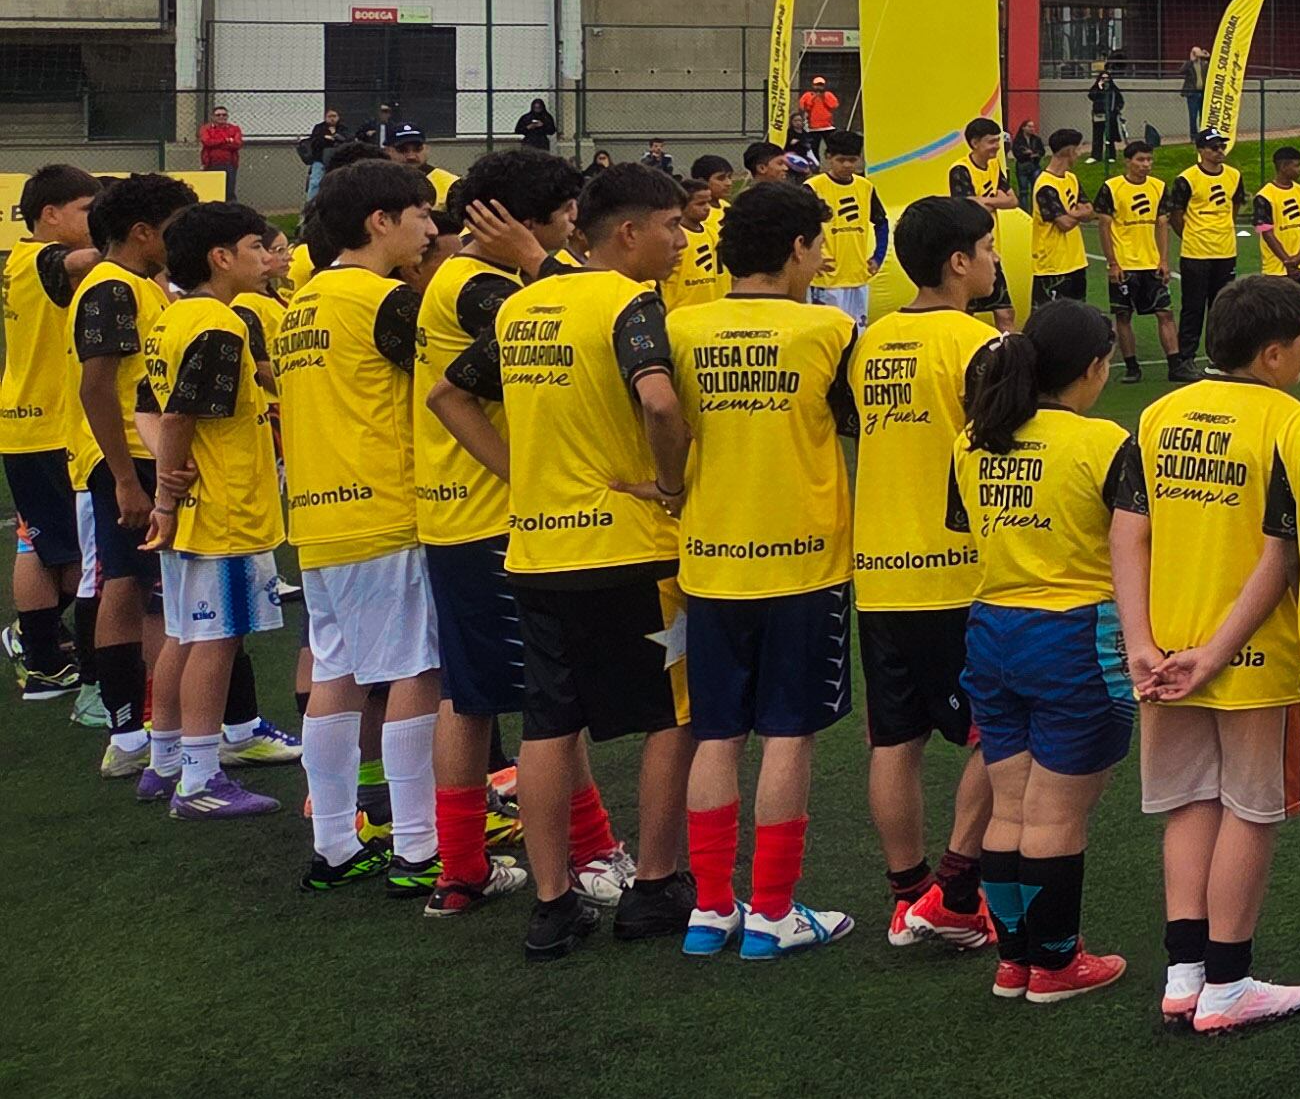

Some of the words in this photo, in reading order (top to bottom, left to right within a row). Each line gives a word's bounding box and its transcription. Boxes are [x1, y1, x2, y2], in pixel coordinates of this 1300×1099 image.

[354, 10, 393, 20] BODEGA
[537, 319, 562, 340] CON
[502, 345, 574, 368] SOLIDARIDAD
[694, 347, 742, 370] JUEGA
[745, 346, 779, 368] CON
[864, 357, 917, 381] RESPETO
[698, 370, 801, 394] SOLIDARIDAD
[700, 397, 793, 413] siempre
[863, 383, 912, 406] DENTRO
[864, 410, 879, 435] y
[882, 404, 932, 426] fuera
[1159, 428, 1202, 453] JUEGA
[1204, 431, 1232, 452] CON
[978, 457, 1043, 483] RESPETO
[1156, 454, 1248, 488] SOLIDARIDAD
[979, 485, 1034, 509] DENTRO
[1155, 483, 1242, 508] siempre
[992, 505, 1054, 532] fuera
[693, 535, 826, 560] Bancolombia
[856, 546, 979, 571] Bancolombia
